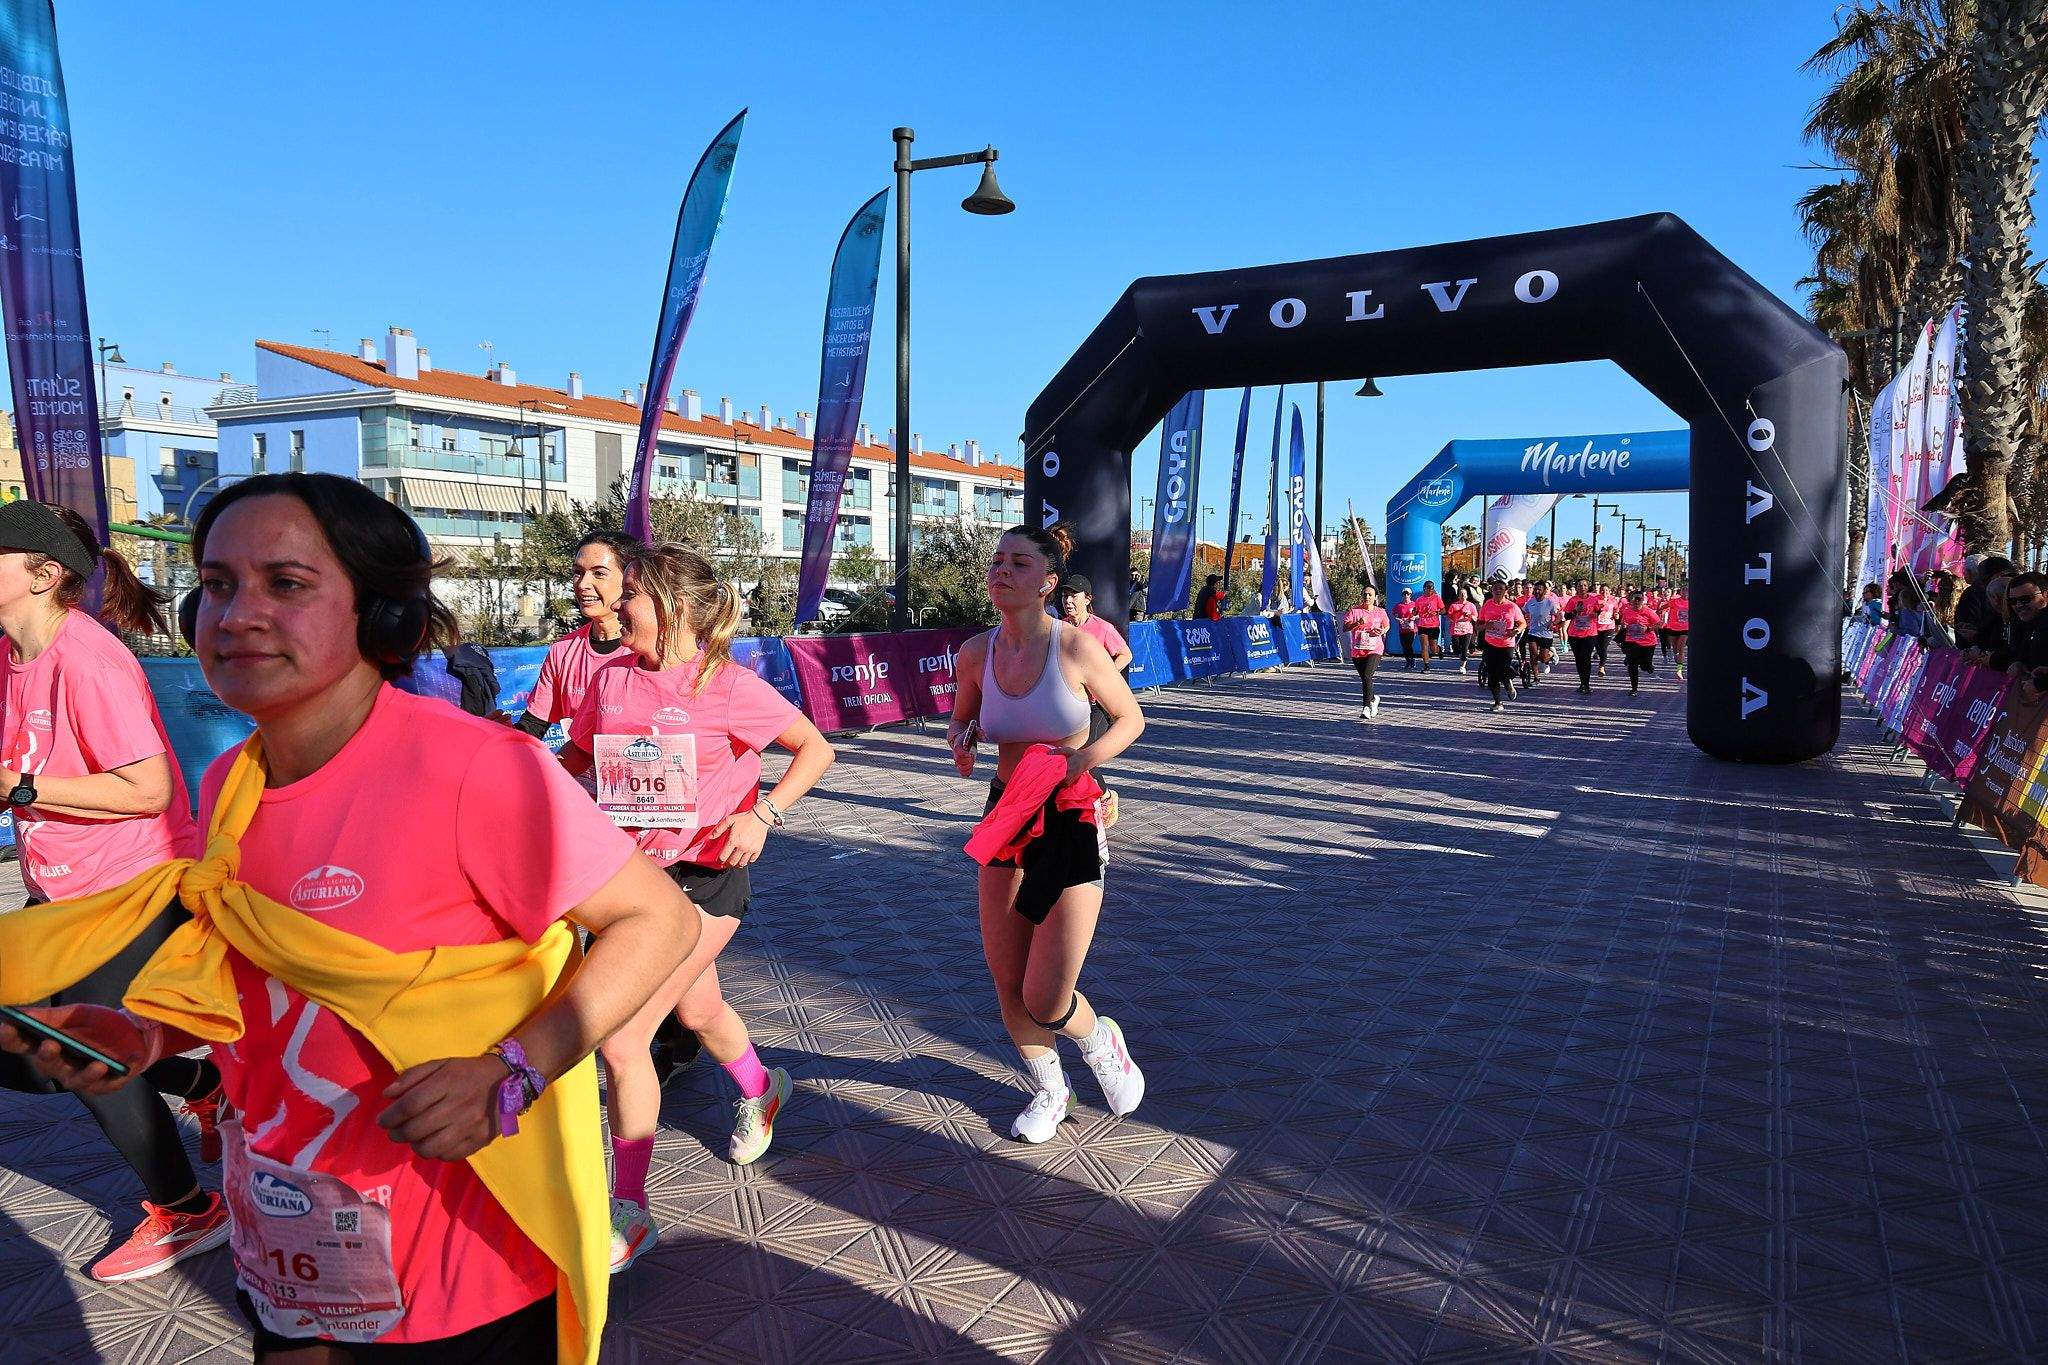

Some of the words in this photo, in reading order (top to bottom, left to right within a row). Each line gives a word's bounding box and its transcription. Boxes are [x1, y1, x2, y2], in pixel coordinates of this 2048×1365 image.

[1191, 269, 1560, 335] VOLVO
[1520, 439, 1630, 487] Marlene
[1741, 417, 1776, 720] VOLVO
[831, 653, 889, 689] renfe
[842, 696, 862, 708] TREN
[863, 692, 893, 705] OFICIAL
[626, 749, 660, 758] ASTURIANA
[629, 777, 666, 792] 016
[636, 796, 655, 804] 8649
[294, 884, 357, 902] ASTURIANA
[268, 1248, 319, 1281] 16
[326, 1318, 381, 1332] ntander
